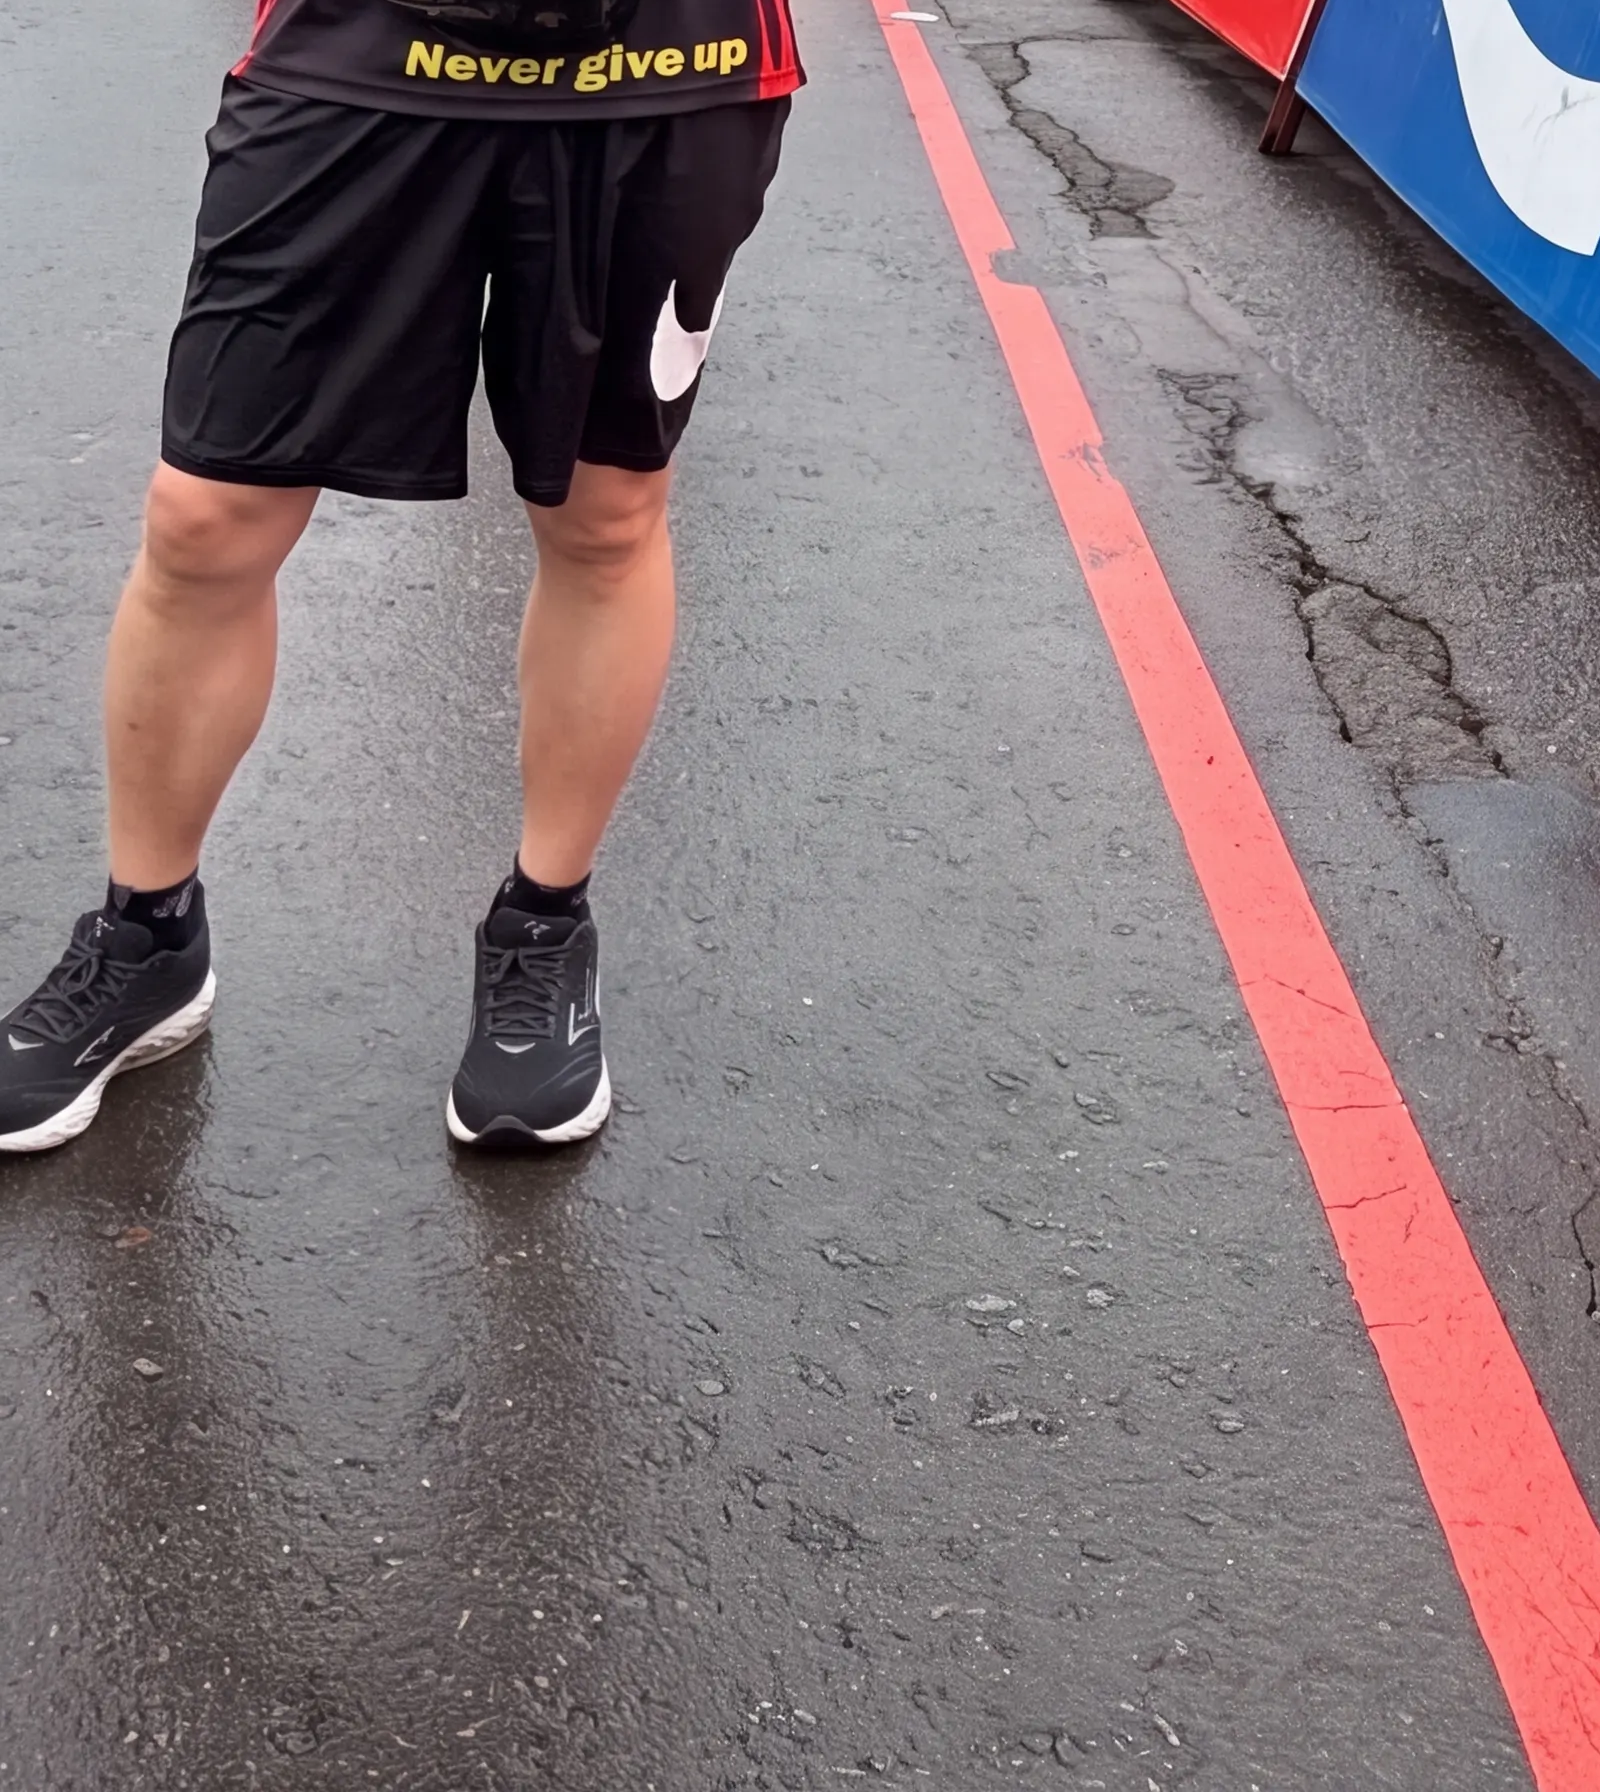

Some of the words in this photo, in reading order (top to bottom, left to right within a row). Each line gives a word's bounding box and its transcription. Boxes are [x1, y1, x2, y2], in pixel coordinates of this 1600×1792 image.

[404, 40, 565, 84] Never
[573, 44, 685, 92] give
[694, 37, 748, 75] up
